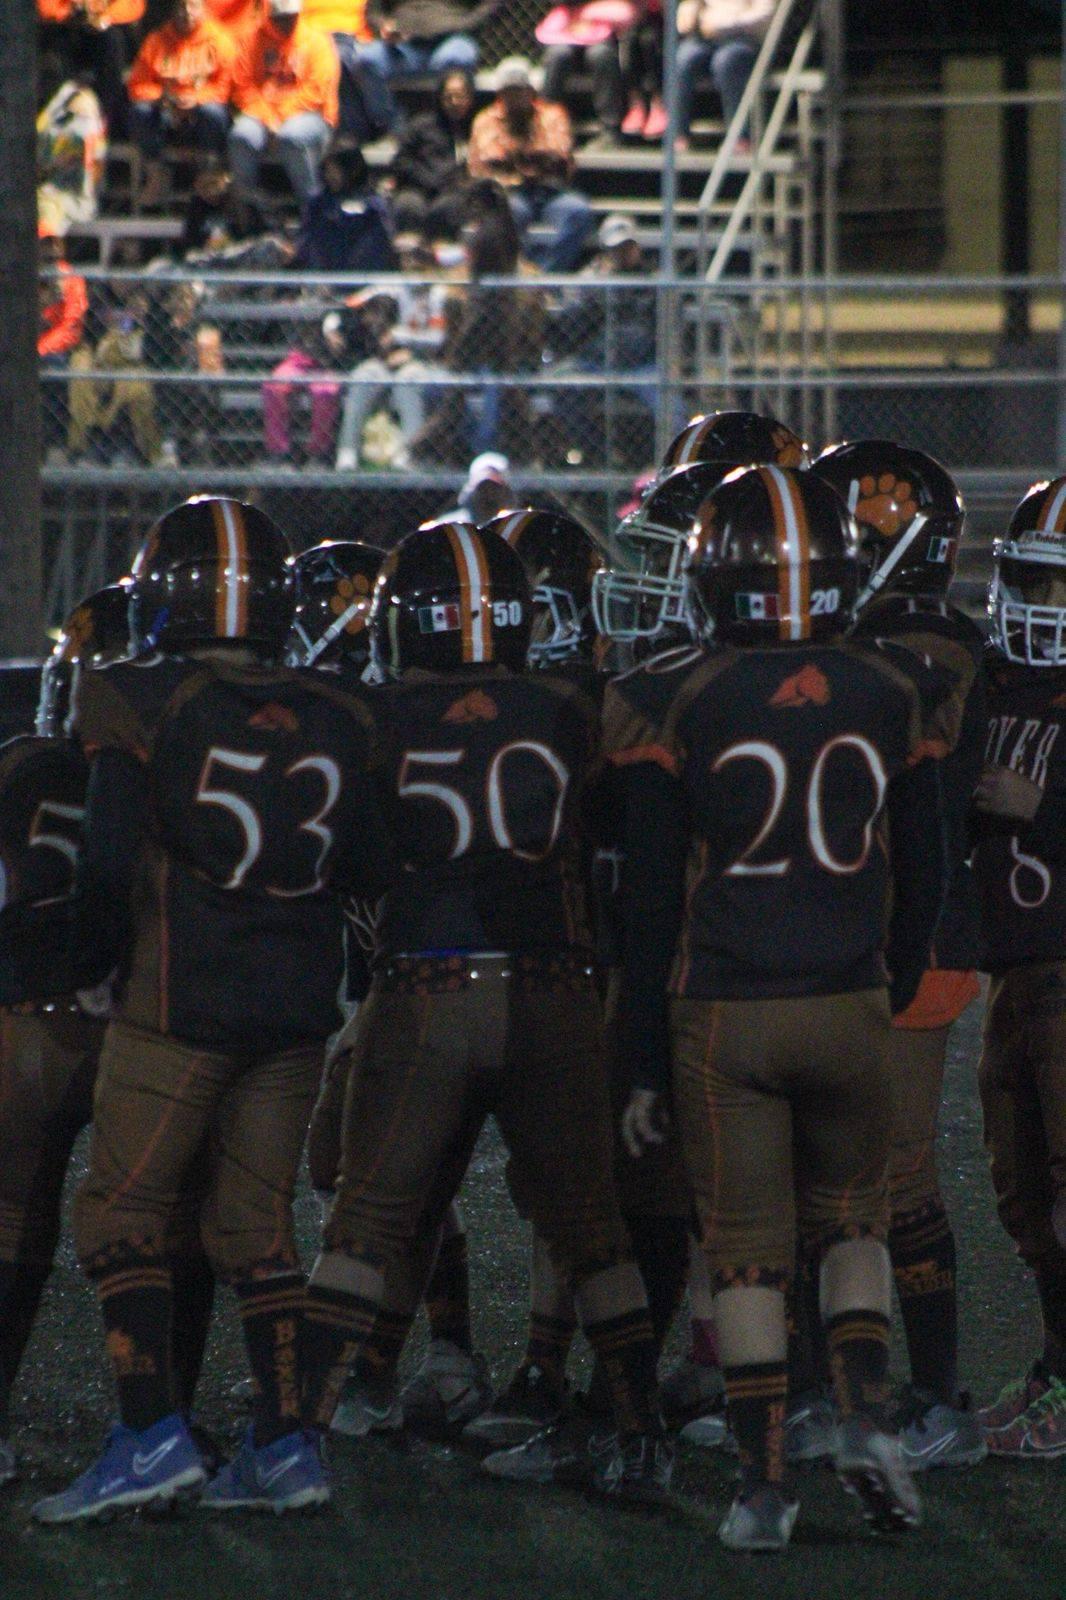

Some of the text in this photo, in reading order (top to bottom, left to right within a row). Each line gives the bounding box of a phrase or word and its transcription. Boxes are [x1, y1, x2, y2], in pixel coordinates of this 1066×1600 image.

[493, 600, 523, 627] 50
[809, 588, 840, 616] 20
[0, 802, 86, 910] 5
[194, 746, 341, 898] 53
[397, 739, 570, 862] 50
[709, 733, 888, 876] 20
